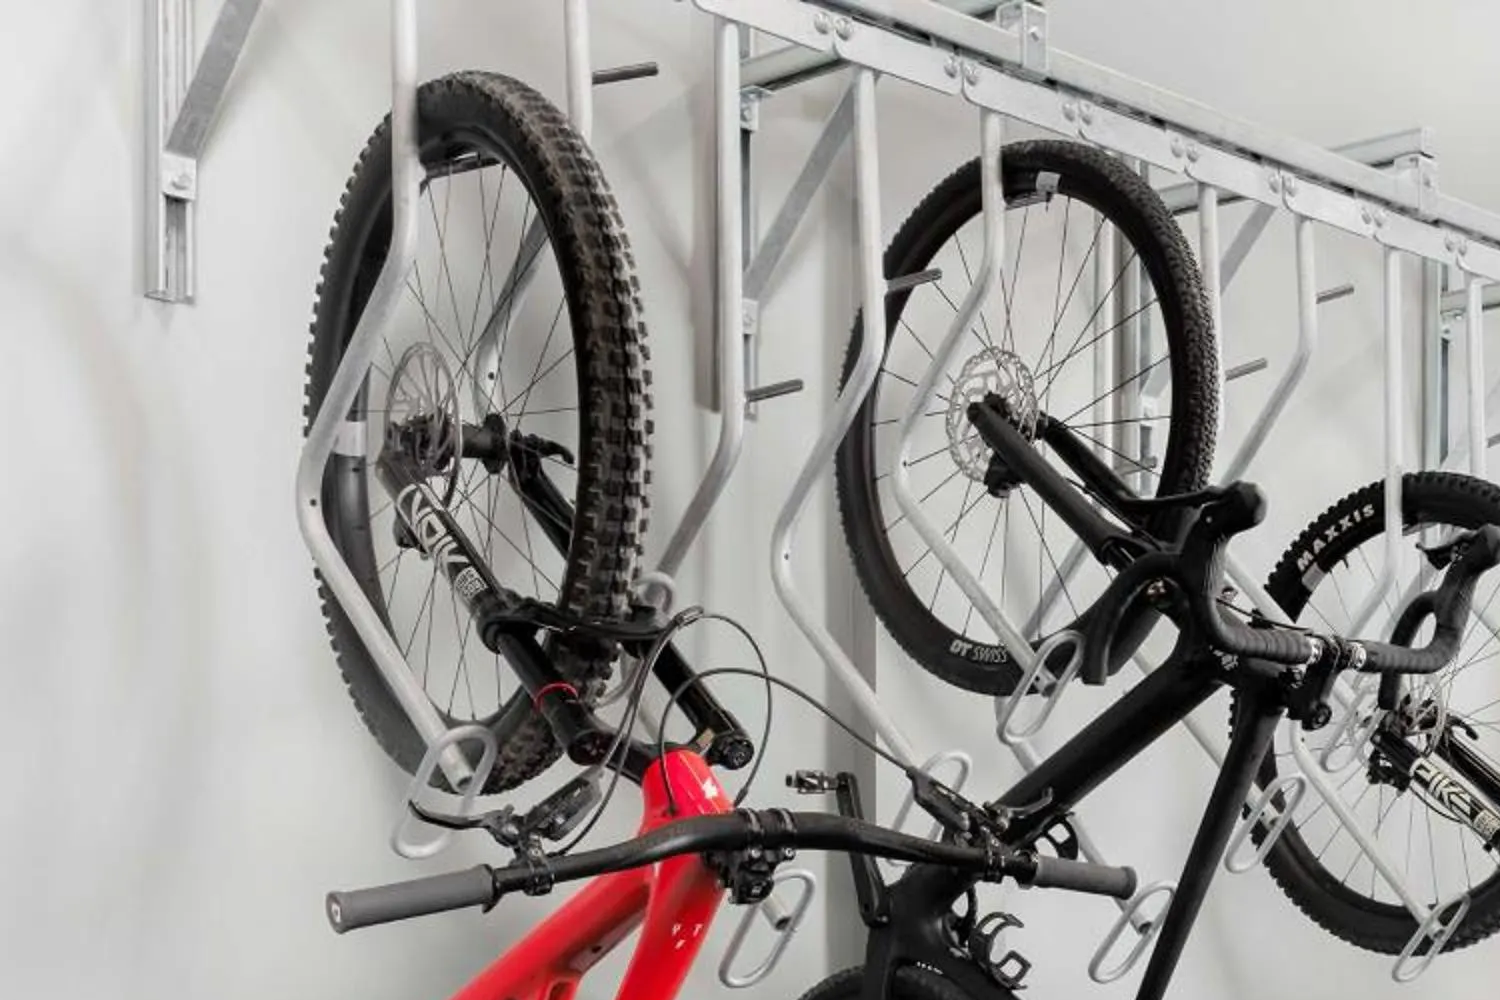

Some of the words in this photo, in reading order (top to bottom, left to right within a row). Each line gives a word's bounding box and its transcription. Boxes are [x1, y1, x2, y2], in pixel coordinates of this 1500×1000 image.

[1297, 504, 1375, 572] MAXXIS
[950, 639, 973, 657] DT
[1409, 757, 1476, 827] PIKE
